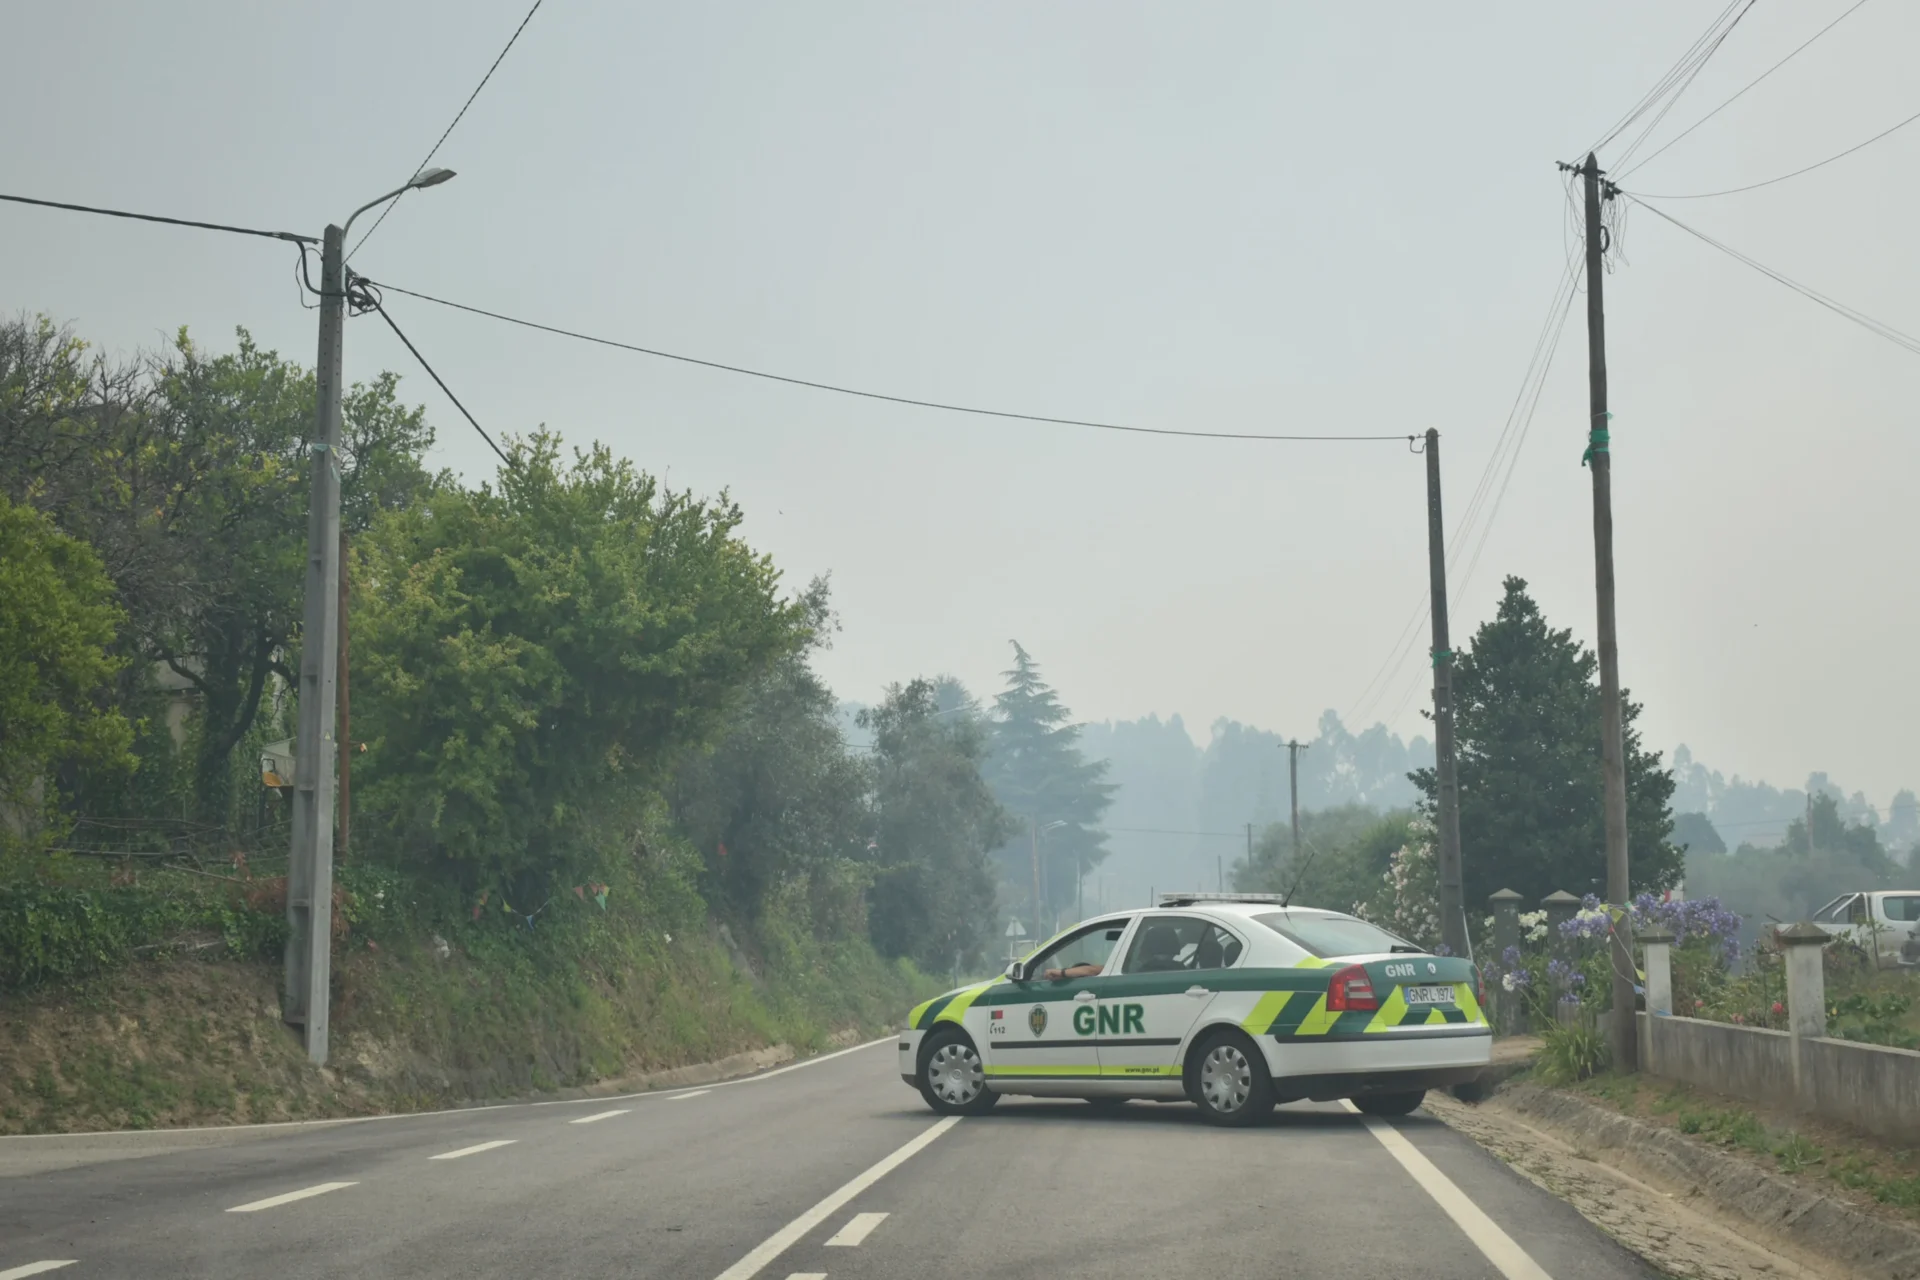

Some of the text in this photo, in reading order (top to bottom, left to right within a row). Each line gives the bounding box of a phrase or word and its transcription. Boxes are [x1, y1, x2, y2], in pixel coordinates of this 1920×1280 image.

[1385, 963, 1416, 977] GNR
[1073, 1003, 1146, 1036] GNR
[994, 1026, 1006, 1034] 112
[1124, 1066, 1160, 1074] www.gnr.pt
